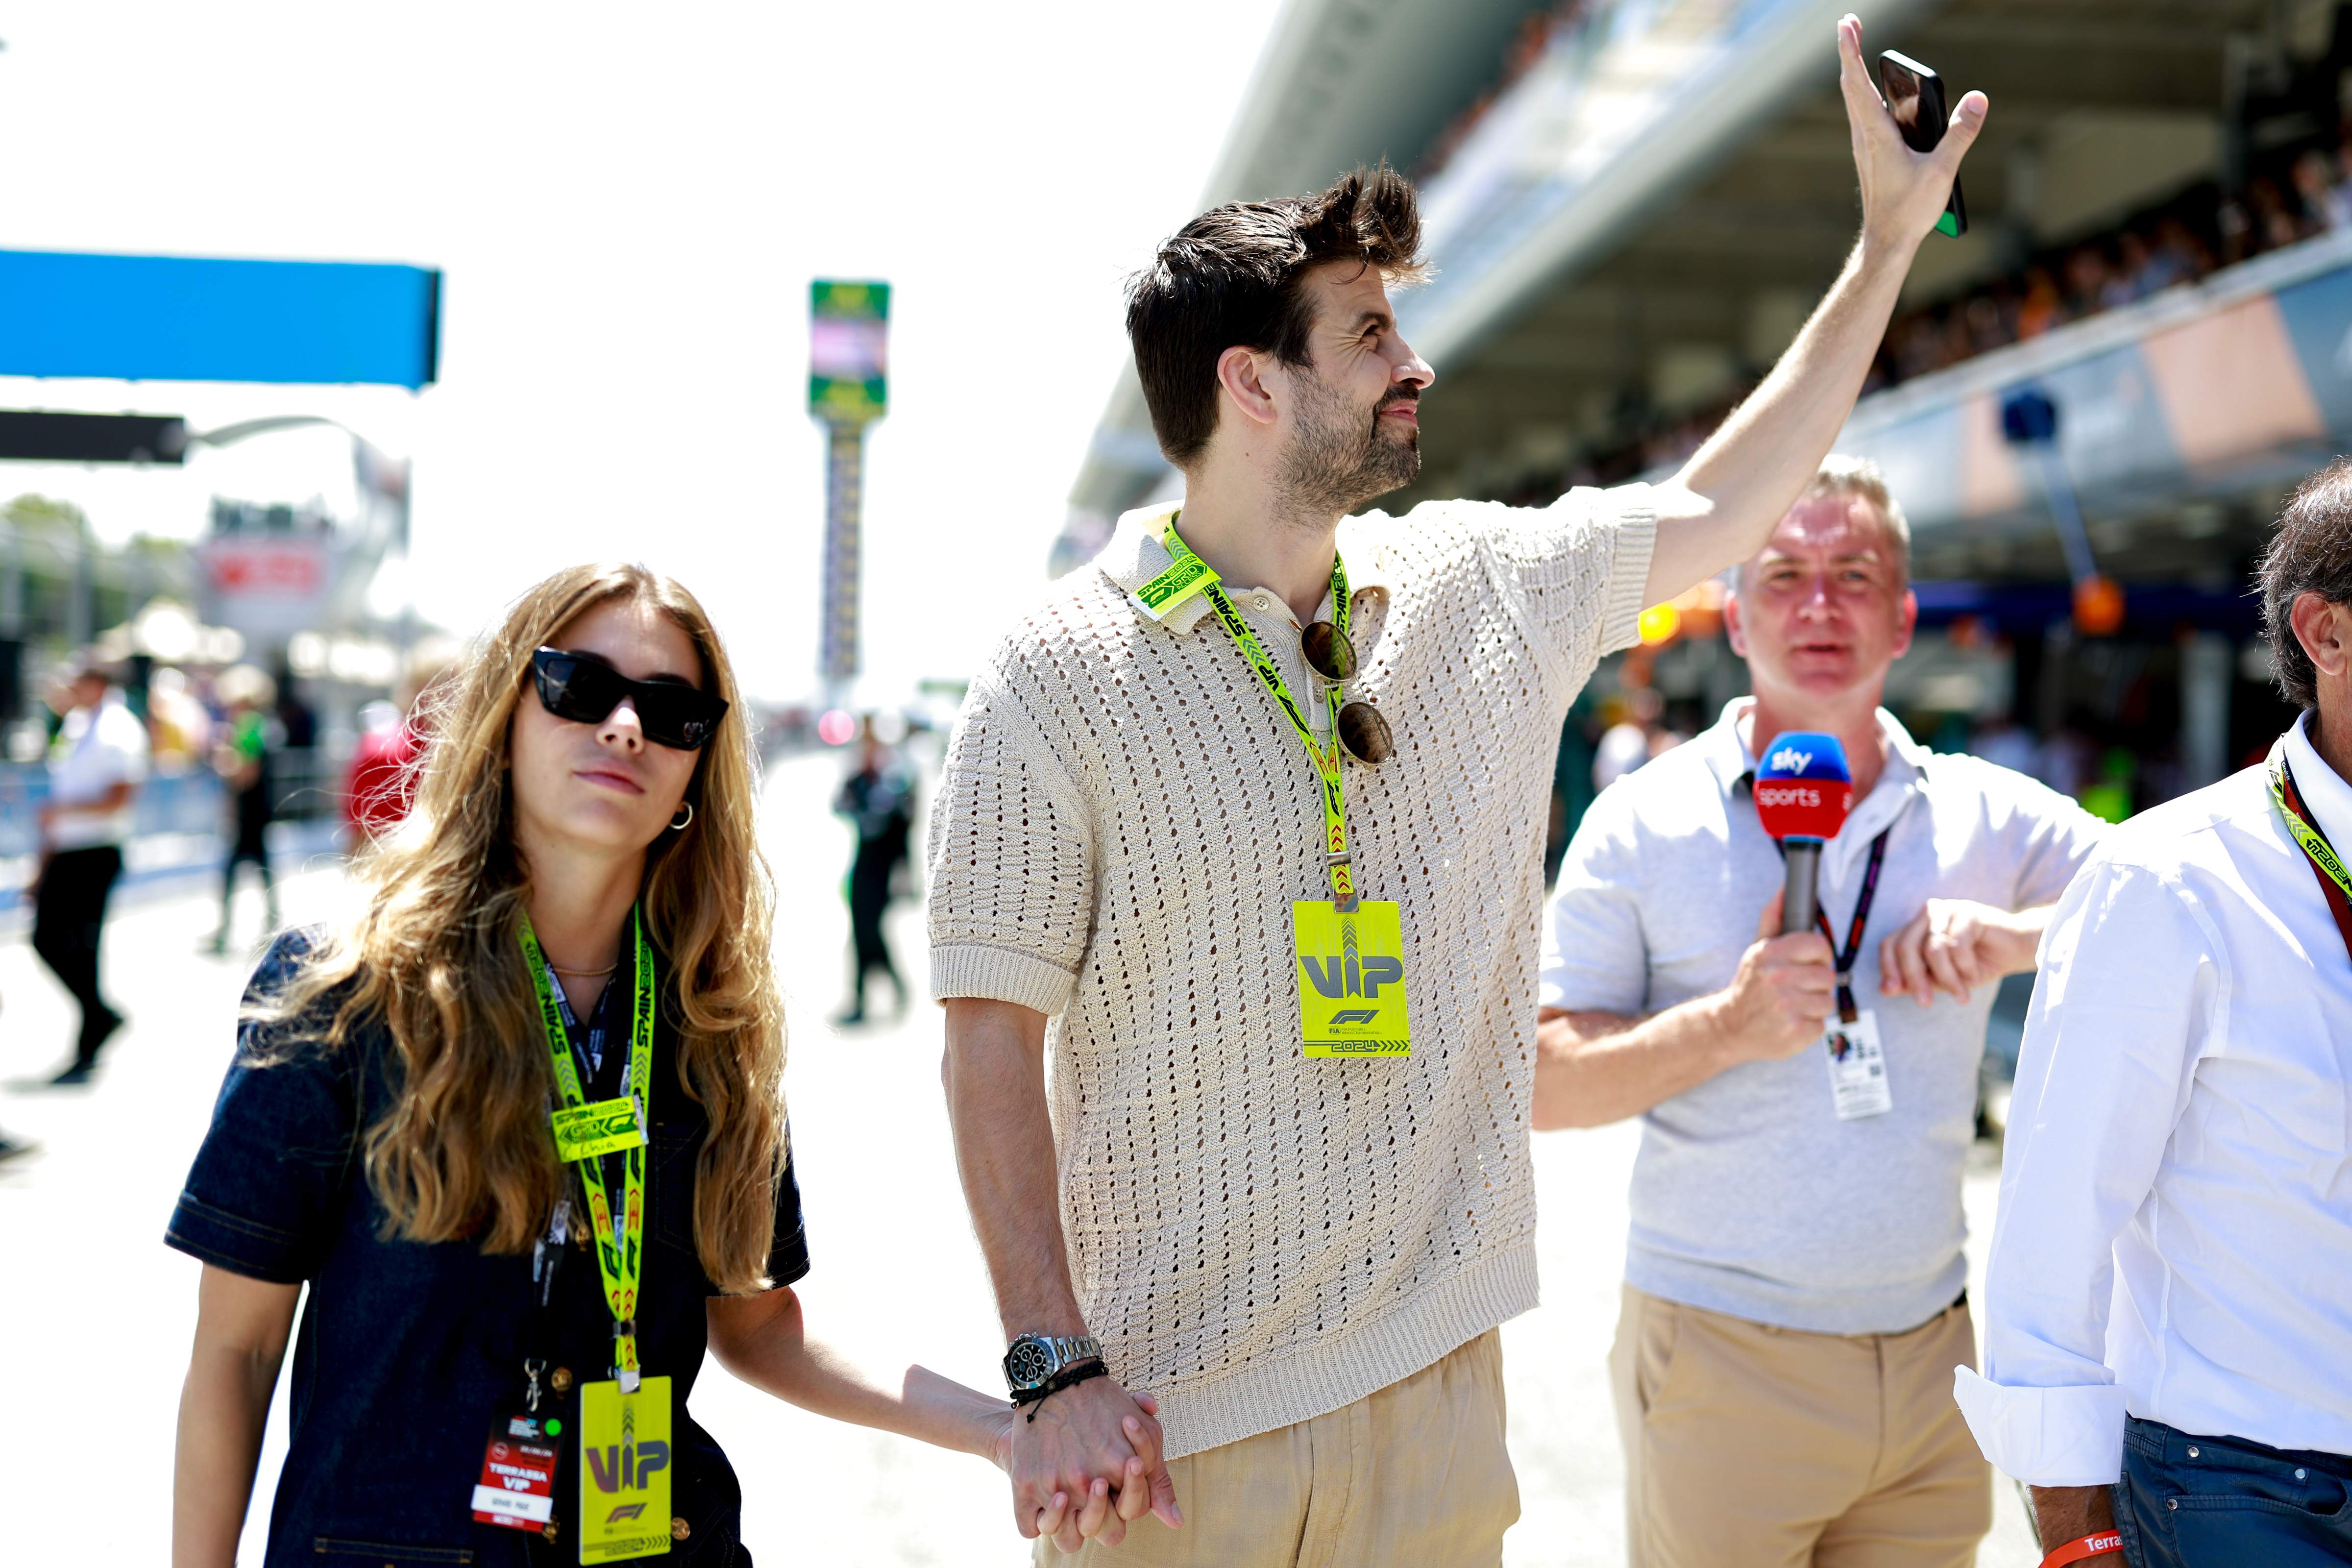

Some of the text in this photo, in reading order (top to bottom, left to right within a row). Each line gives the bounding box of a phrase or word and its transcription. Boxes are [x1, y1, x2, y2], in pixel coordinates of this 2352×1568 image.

[1171, 565, 1198, 587] GRID
[1176, 571, 1202, 590] ACCESS
[1258, 664, 1279, 692] VIP
[1770, 746, 1813, 776] sky
[1758, 787, 1821, 809] sports
[1299, 956, 1403, 999] VIP
[1328, 1009, 1380, 1024] F1
[1332, 1041, 1379, 1051] 2024
[489, 1462, 548, 1483] TERRASSA
[585, 1440, 670, 1494] VIP
[502, 1475, 532, 1492] VIP
[605, 1502, 648, 1524] F1
